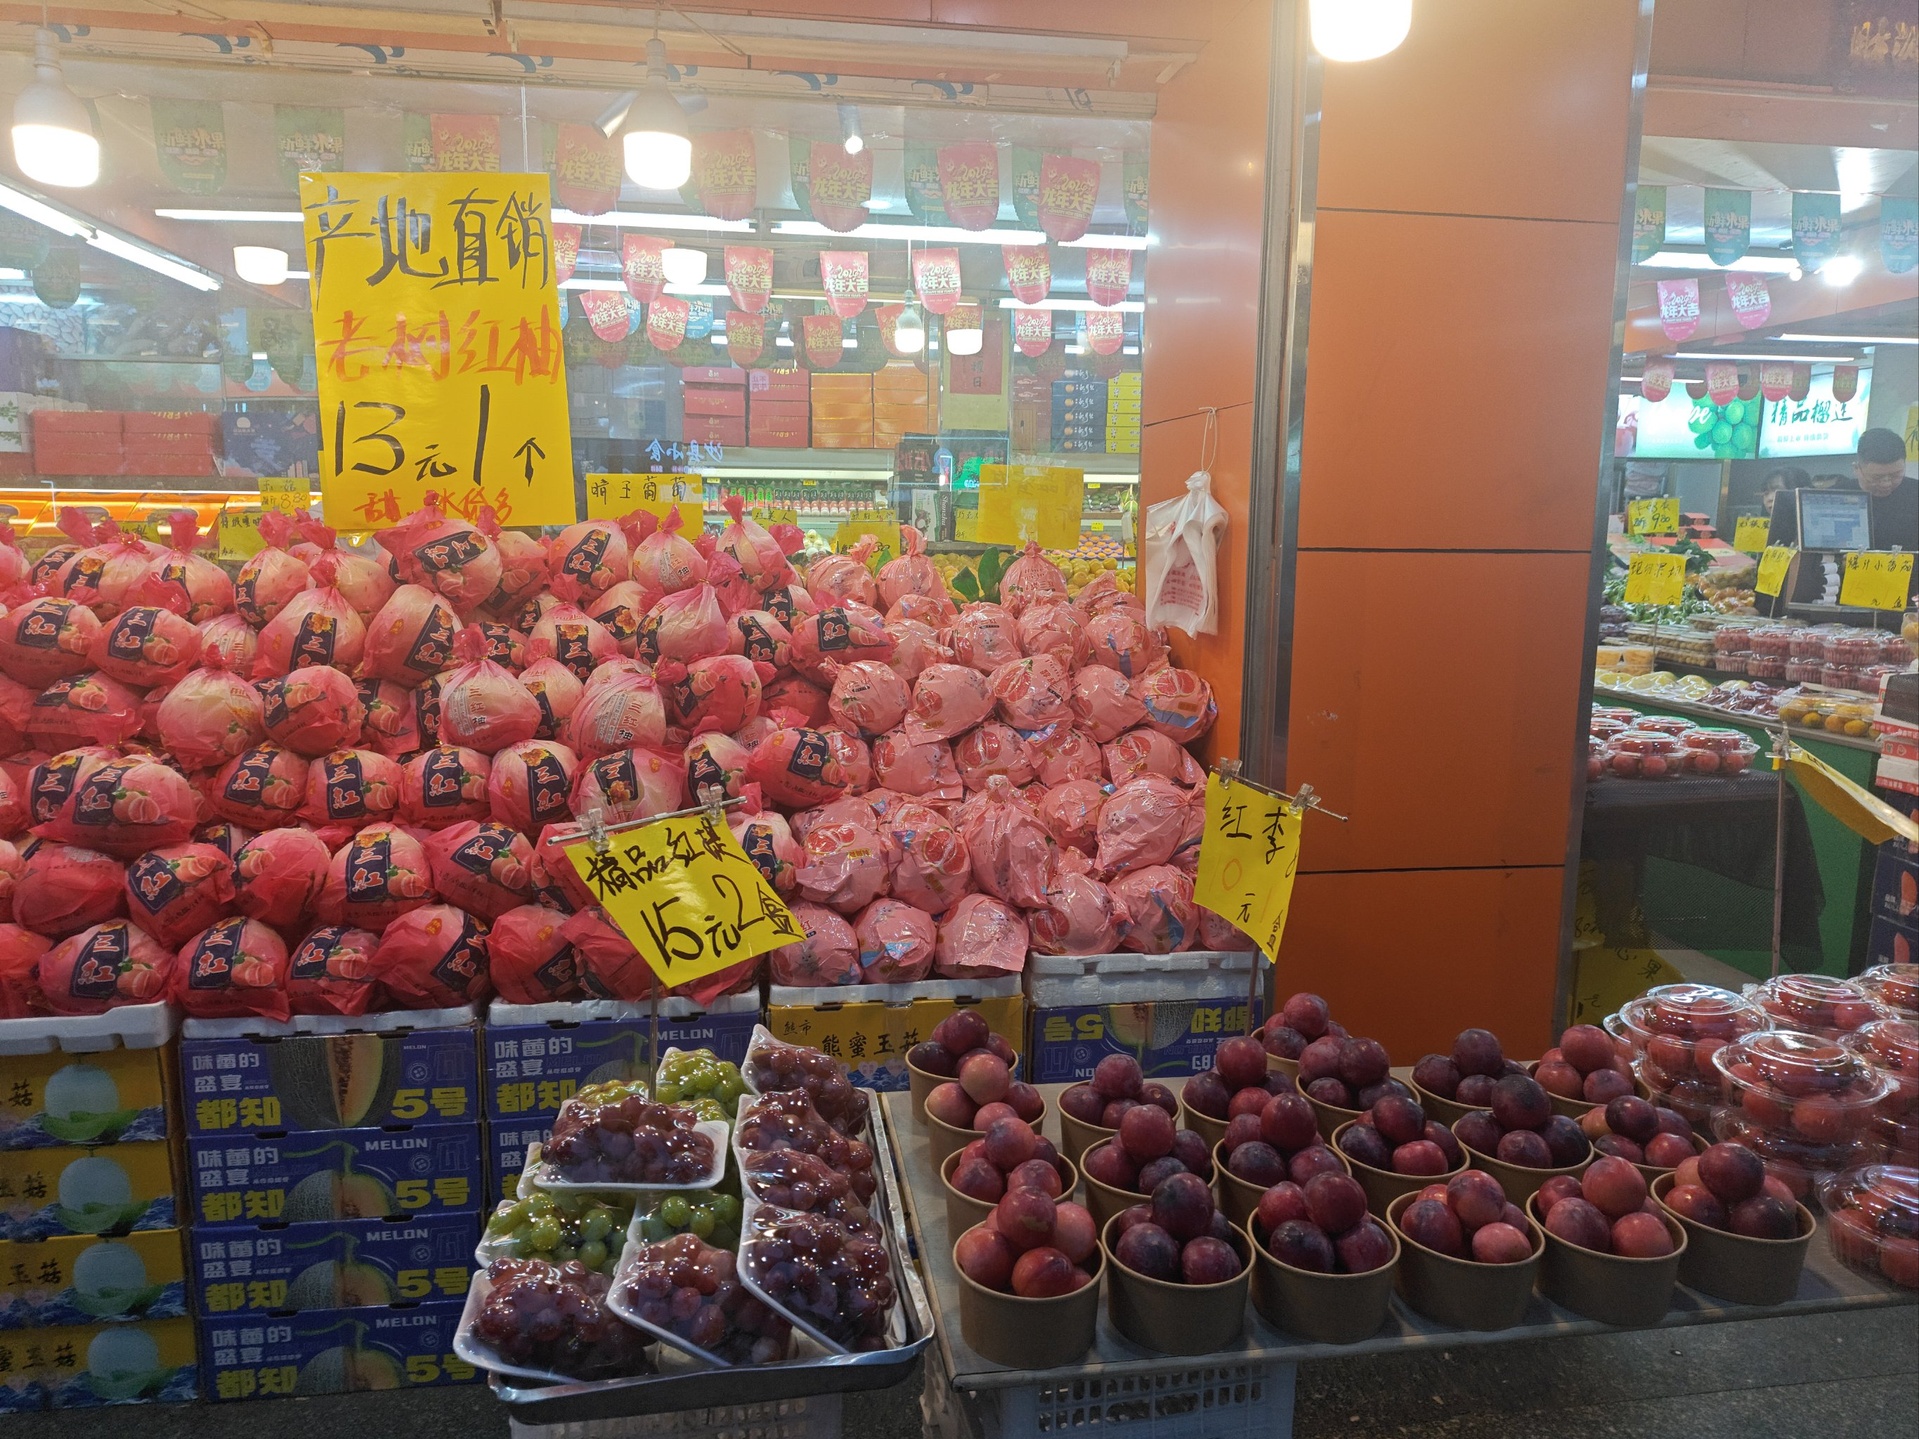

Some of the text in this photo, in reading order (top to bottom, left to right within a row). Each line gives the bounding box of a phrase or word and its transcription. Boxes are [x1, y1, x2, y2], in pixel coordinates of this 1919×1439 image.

[945, 180, 999, 200] 龙年大吉
[1042, 188, 1096, 211] 龙年大吉
[305, 186, 551, 312] 产地直销
[727, 271, 772, 289] 龙年大吉
[1009, 264, 1050, 281] 龙年大吉
[1087, 267, 1130, 284] 龙年大吉
[825, 277, 868, 292] 龙年大吉
[1732, 290, 1770, 309] 龙年大吉
[1661, 302, 1700, 319] 龙年大吉
[1017, 325, 1051, 337] 龙年大吉
[1089, 323, 1123, 335] 龙年大吉
[318, 303, 563, 386] 老树红柚
[617, 698, 643, 742] 三红柚
[656, 1028, 714, 1041] MELON
[1043, 1014, 1104, 1042] 5号
[494, 1036, 572, 1059] 味蕾的
[192, 1052, 260, 1070] 味蕾的
[496, 1059, 543, 1078] 盛宴
[194, 1074, 243, 1093] 盛宴
[391, 1086, 468, 1119] 5号
[497, 1079, 577, 1113] 都知
[196, 1096, 281, 1130] 都知
[365, 1137, 428, 1151] MELON
[198, 1146, 279, 1168] 味蕾的
[200, 1168, 249, 1187] 盛宴
[396, 1176, 470, 1209] 5号
[202, 1188, 285, 1222] 都知
[366, 1228, 429, 1242] MELON
[201, 1238, 281, 1260] 味蕾的
[203, 1260, 252, 1279] 盛宴
[397, 1266, 470, 1298] 5号
[206, 1279, 288, 1312] 都知
[375, 1314, 437, 1329] MELON
[212, 1325, 292, 1348] 味蕾的
[214, 1347, 263, 1366] 盛宴
[406, 1354, 477, 1383] 5号
[216, 1365, 298, 1399] 都知
